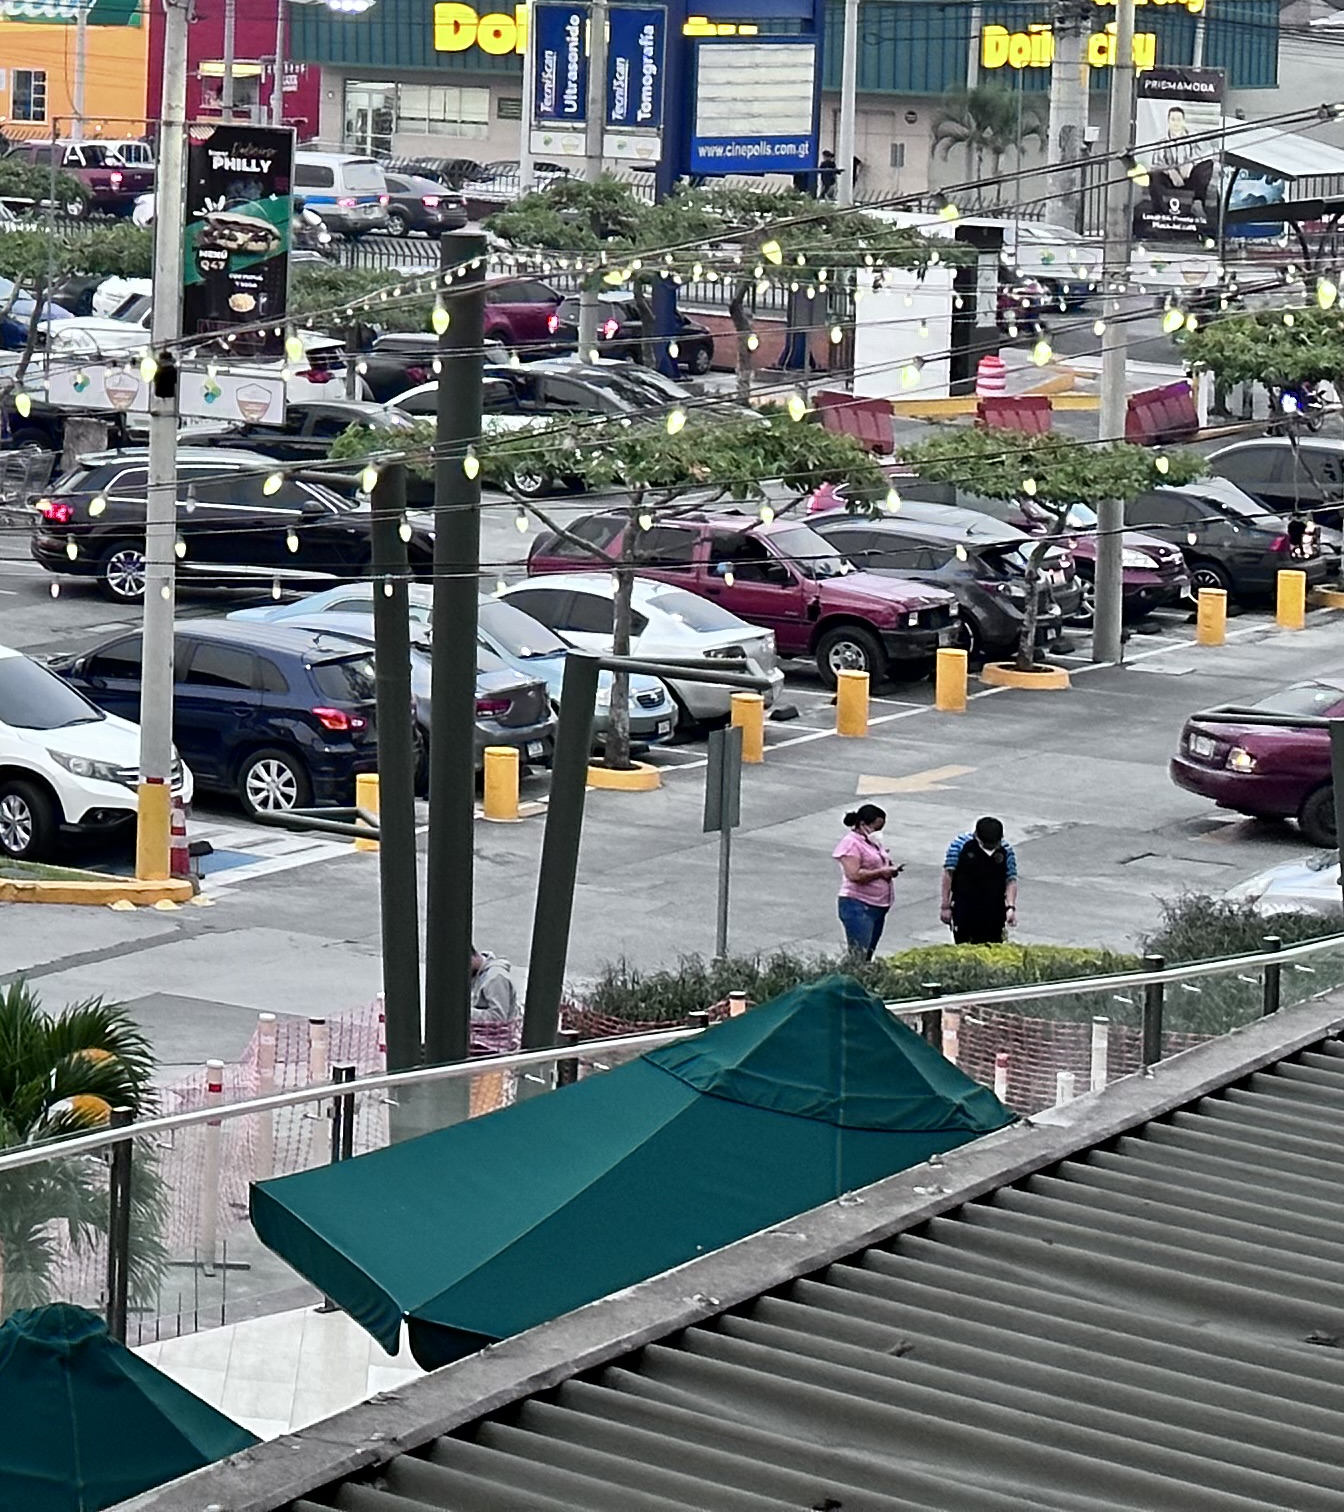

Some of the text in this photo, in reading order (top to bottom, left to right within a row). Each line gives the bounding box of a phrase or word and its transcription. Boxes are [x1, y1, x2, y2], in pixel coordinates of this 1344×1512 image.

[540, 50, 556, 113] TecniScan
[563, 14, 581, 113] Ultrasonido
[612, 57, 628, 120] TecniScan
[637, 24, 657, 122] Tomografía
[212, 156, 272, 173] PHILLY
[698, 140, 810, 160] www.cinepolis.com.gt
